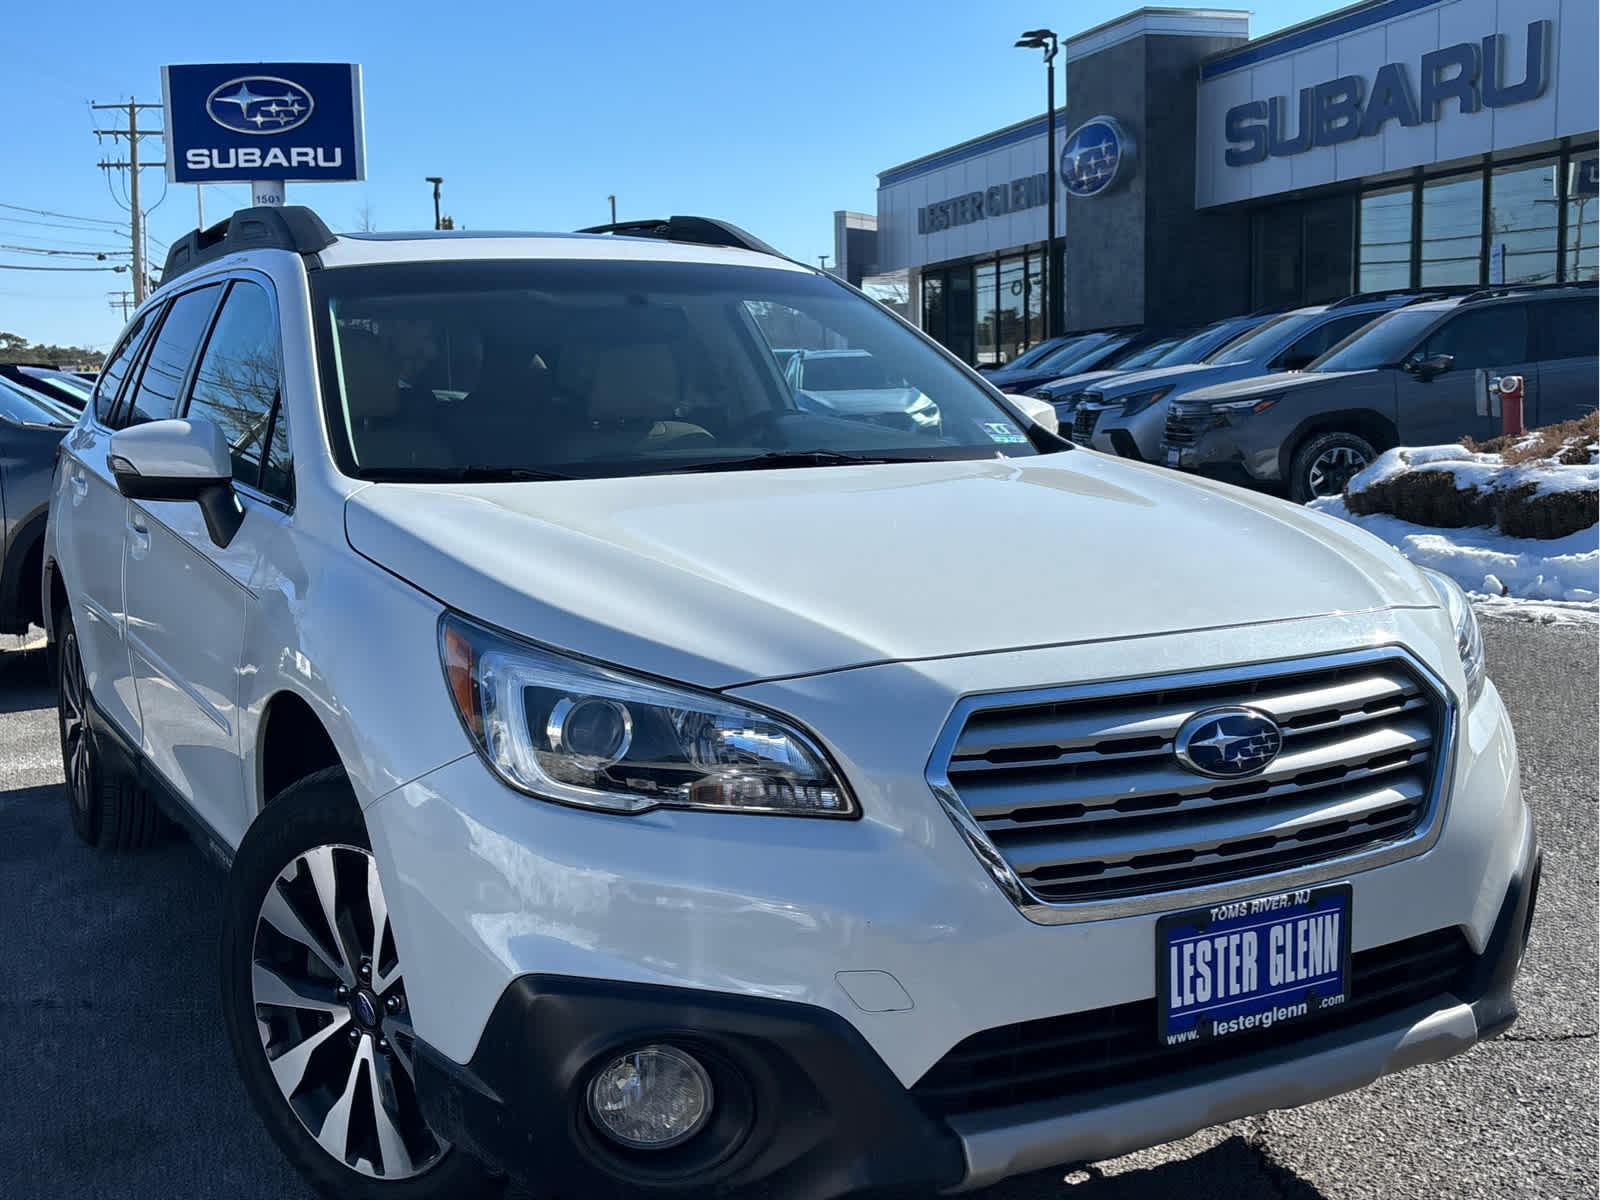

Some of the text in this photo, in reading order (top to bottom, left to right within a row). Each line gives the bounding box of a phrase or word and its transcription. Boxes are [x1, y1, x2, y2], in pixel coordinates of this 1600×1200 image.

[1225, 20, 1551, 168] SUBARU
[186, 147, 342, 169] SUBARU
[918, 191, 985, 235] LESTER
[1210, 902, 1248, 922] TOMS
[1294, 889, 1312, 905] NJ
[1170, 913, 1340, 1009] LESTER GLENN
[1167, 994, 1345, 1045] www. lesterglenn .com
